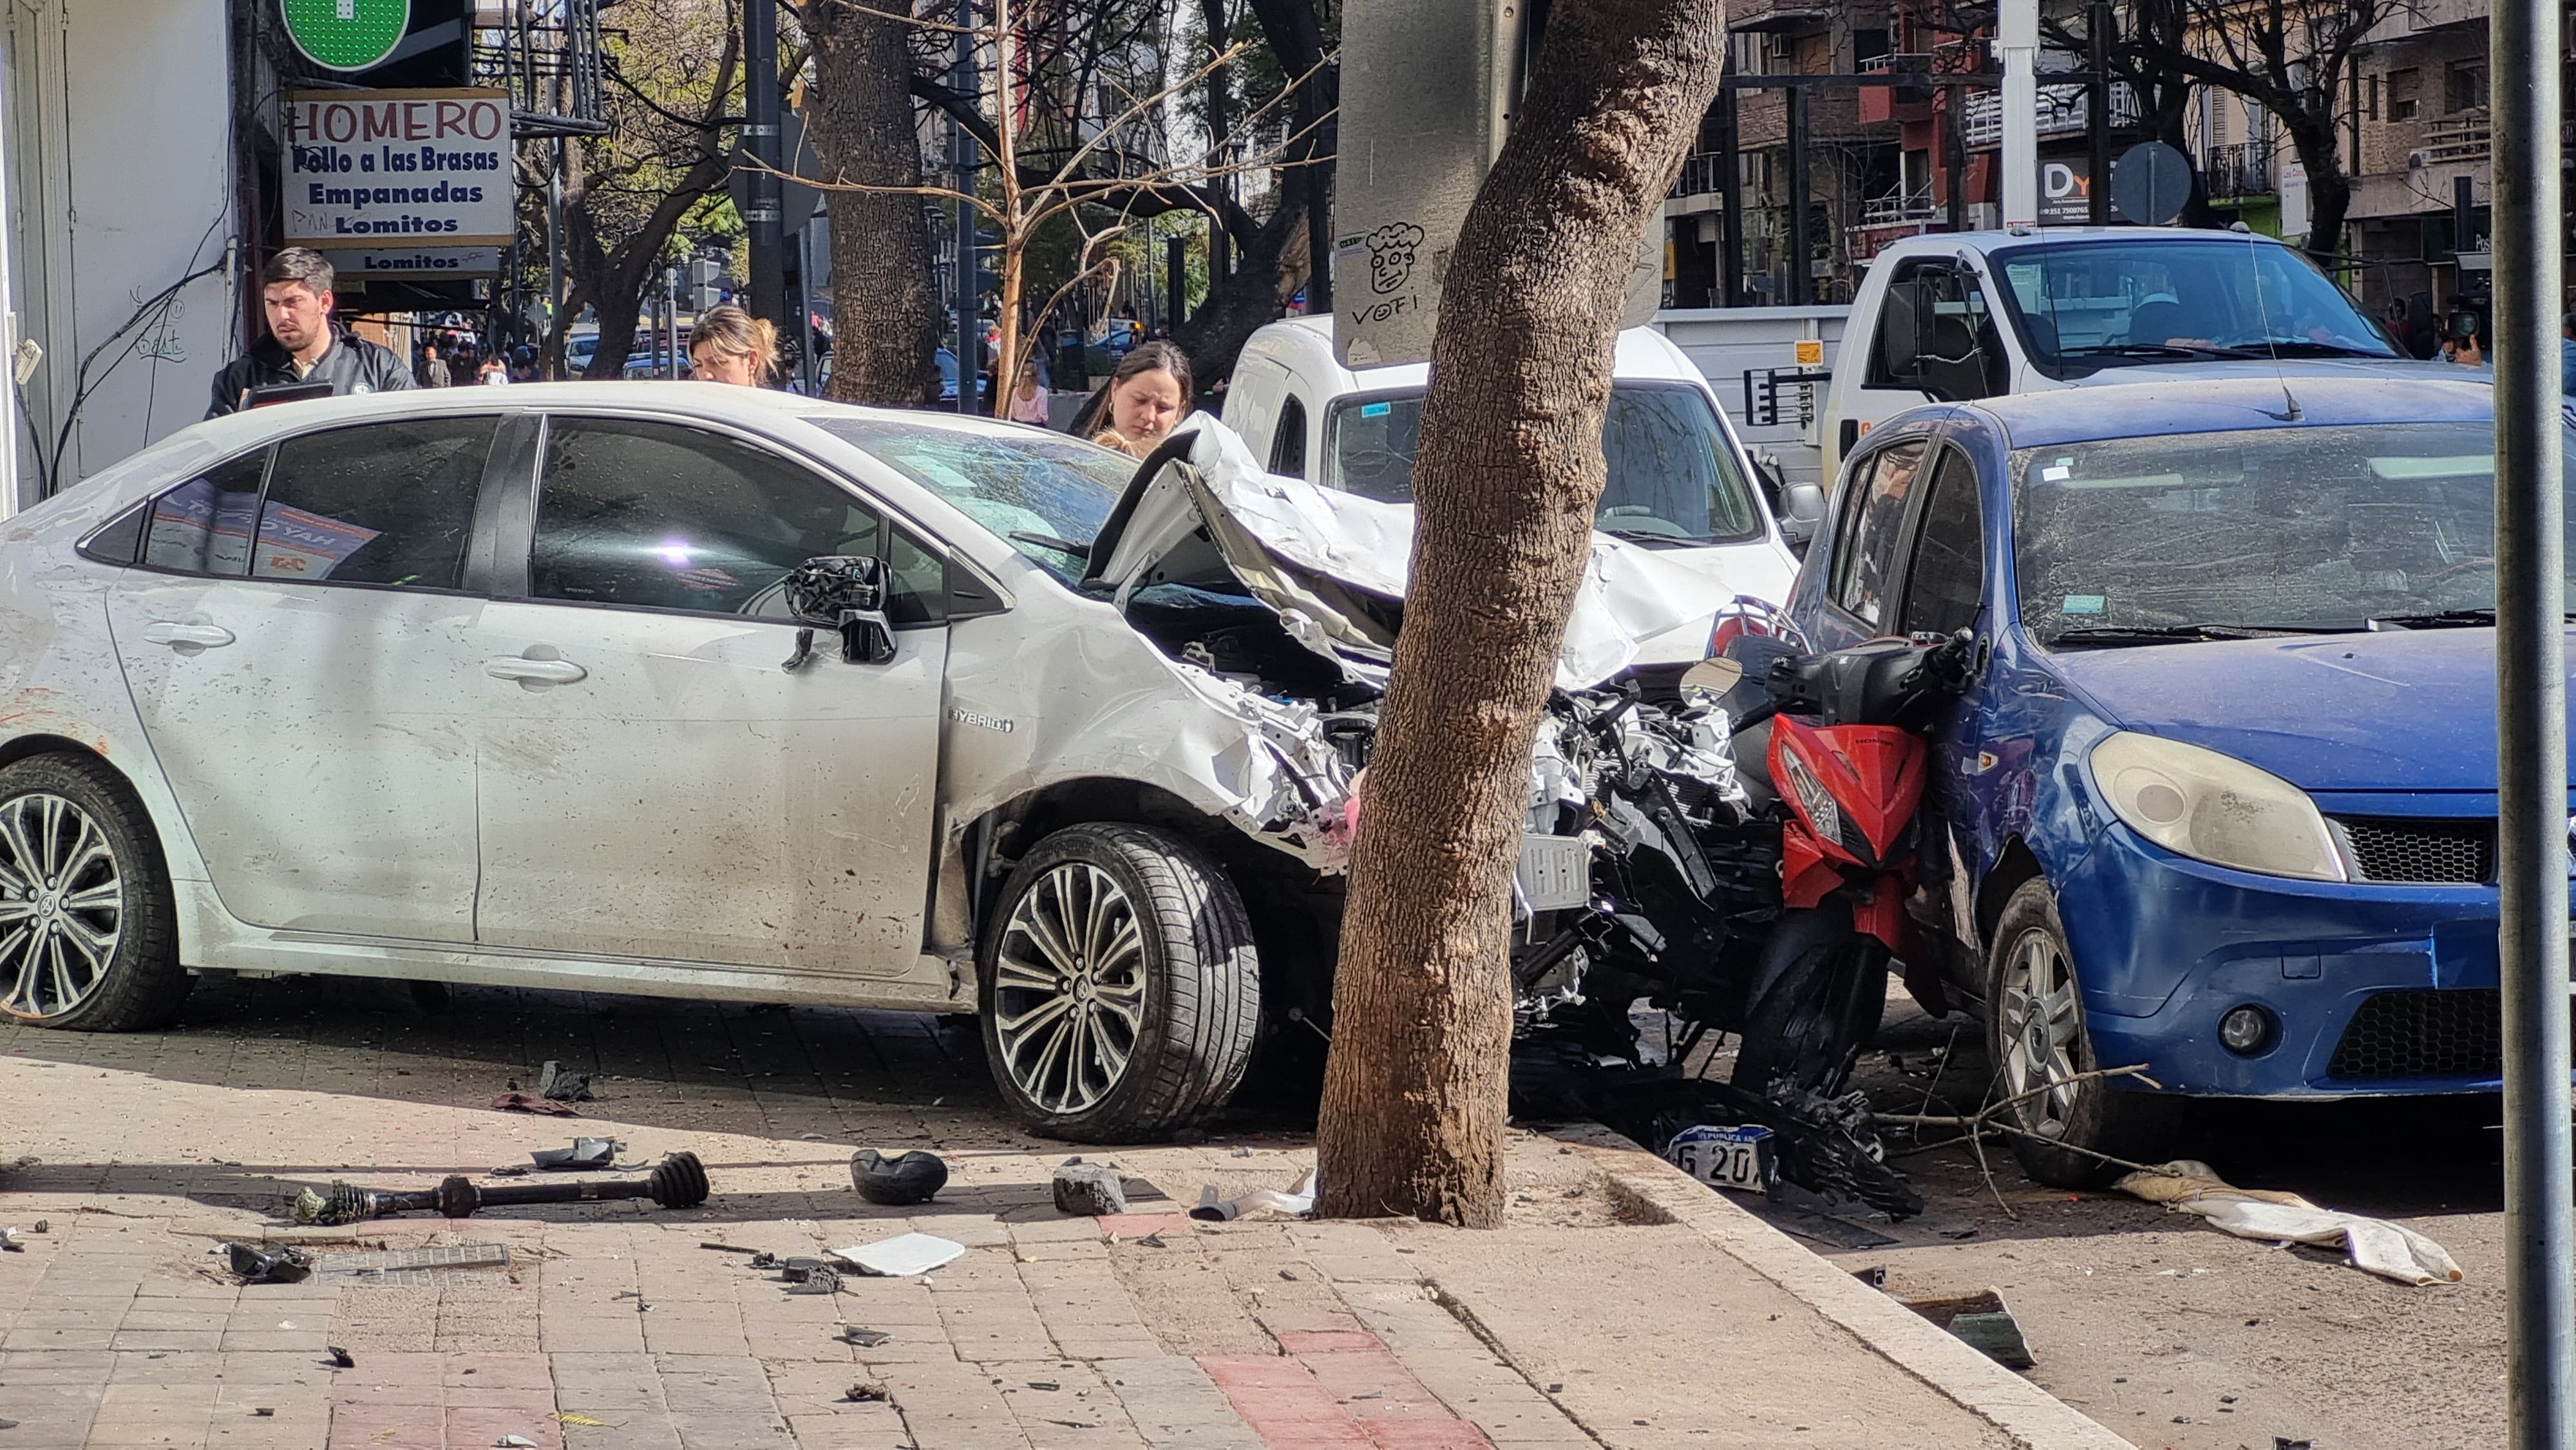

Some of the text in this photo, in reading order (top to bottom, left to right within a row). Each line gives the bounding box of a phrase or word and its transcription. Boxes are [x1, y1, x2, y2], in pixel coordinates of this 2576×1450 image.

[287, 101, 502, 142] HOMERO
[292, 146, 498, 173] Pollo a las Brasas
[309, 180, 484, 209] Empanadas
[336, 215, 459, 234] Lomitos
[2476, 233, 2492, 252] Pos
[365, 256, 459, 270] Lomitos
[949, 708, 1003, 731] HYBRID
